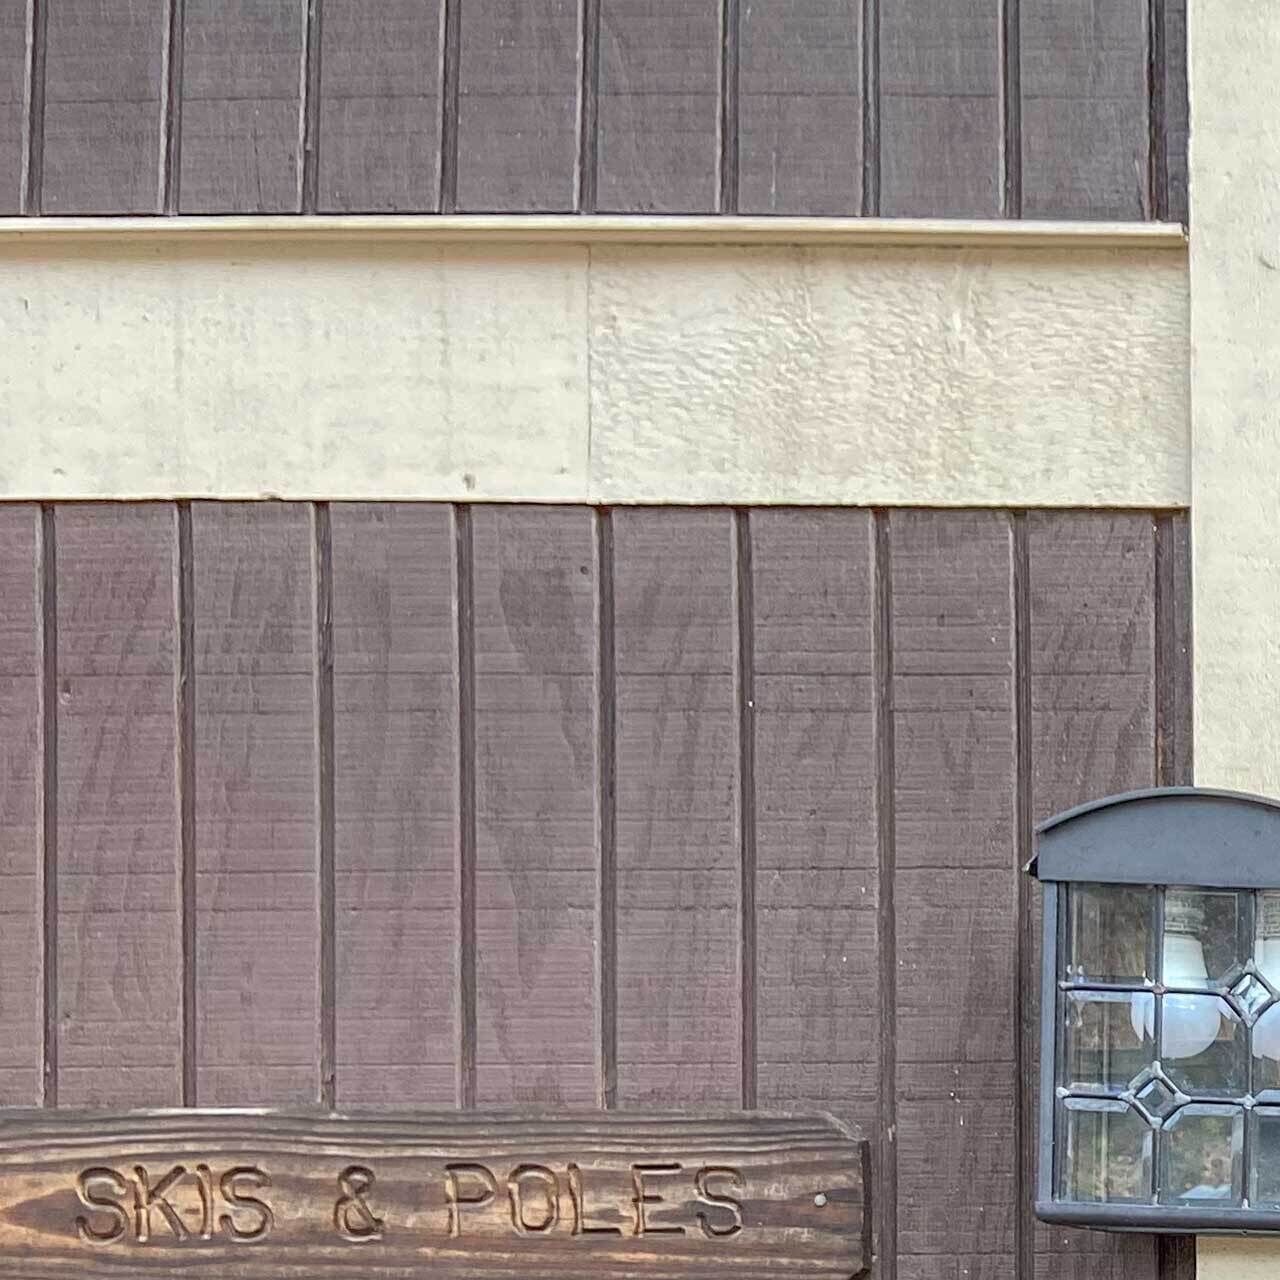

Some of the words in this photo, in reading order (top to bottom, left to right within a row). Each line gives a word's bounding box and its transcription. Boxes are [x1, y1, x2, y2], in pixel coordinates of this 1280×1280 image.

[75, 1164, 274, 1244] SKIS
[334, 1165, 384, 1242] &
[444, 1162, 747, 1239] POLES
